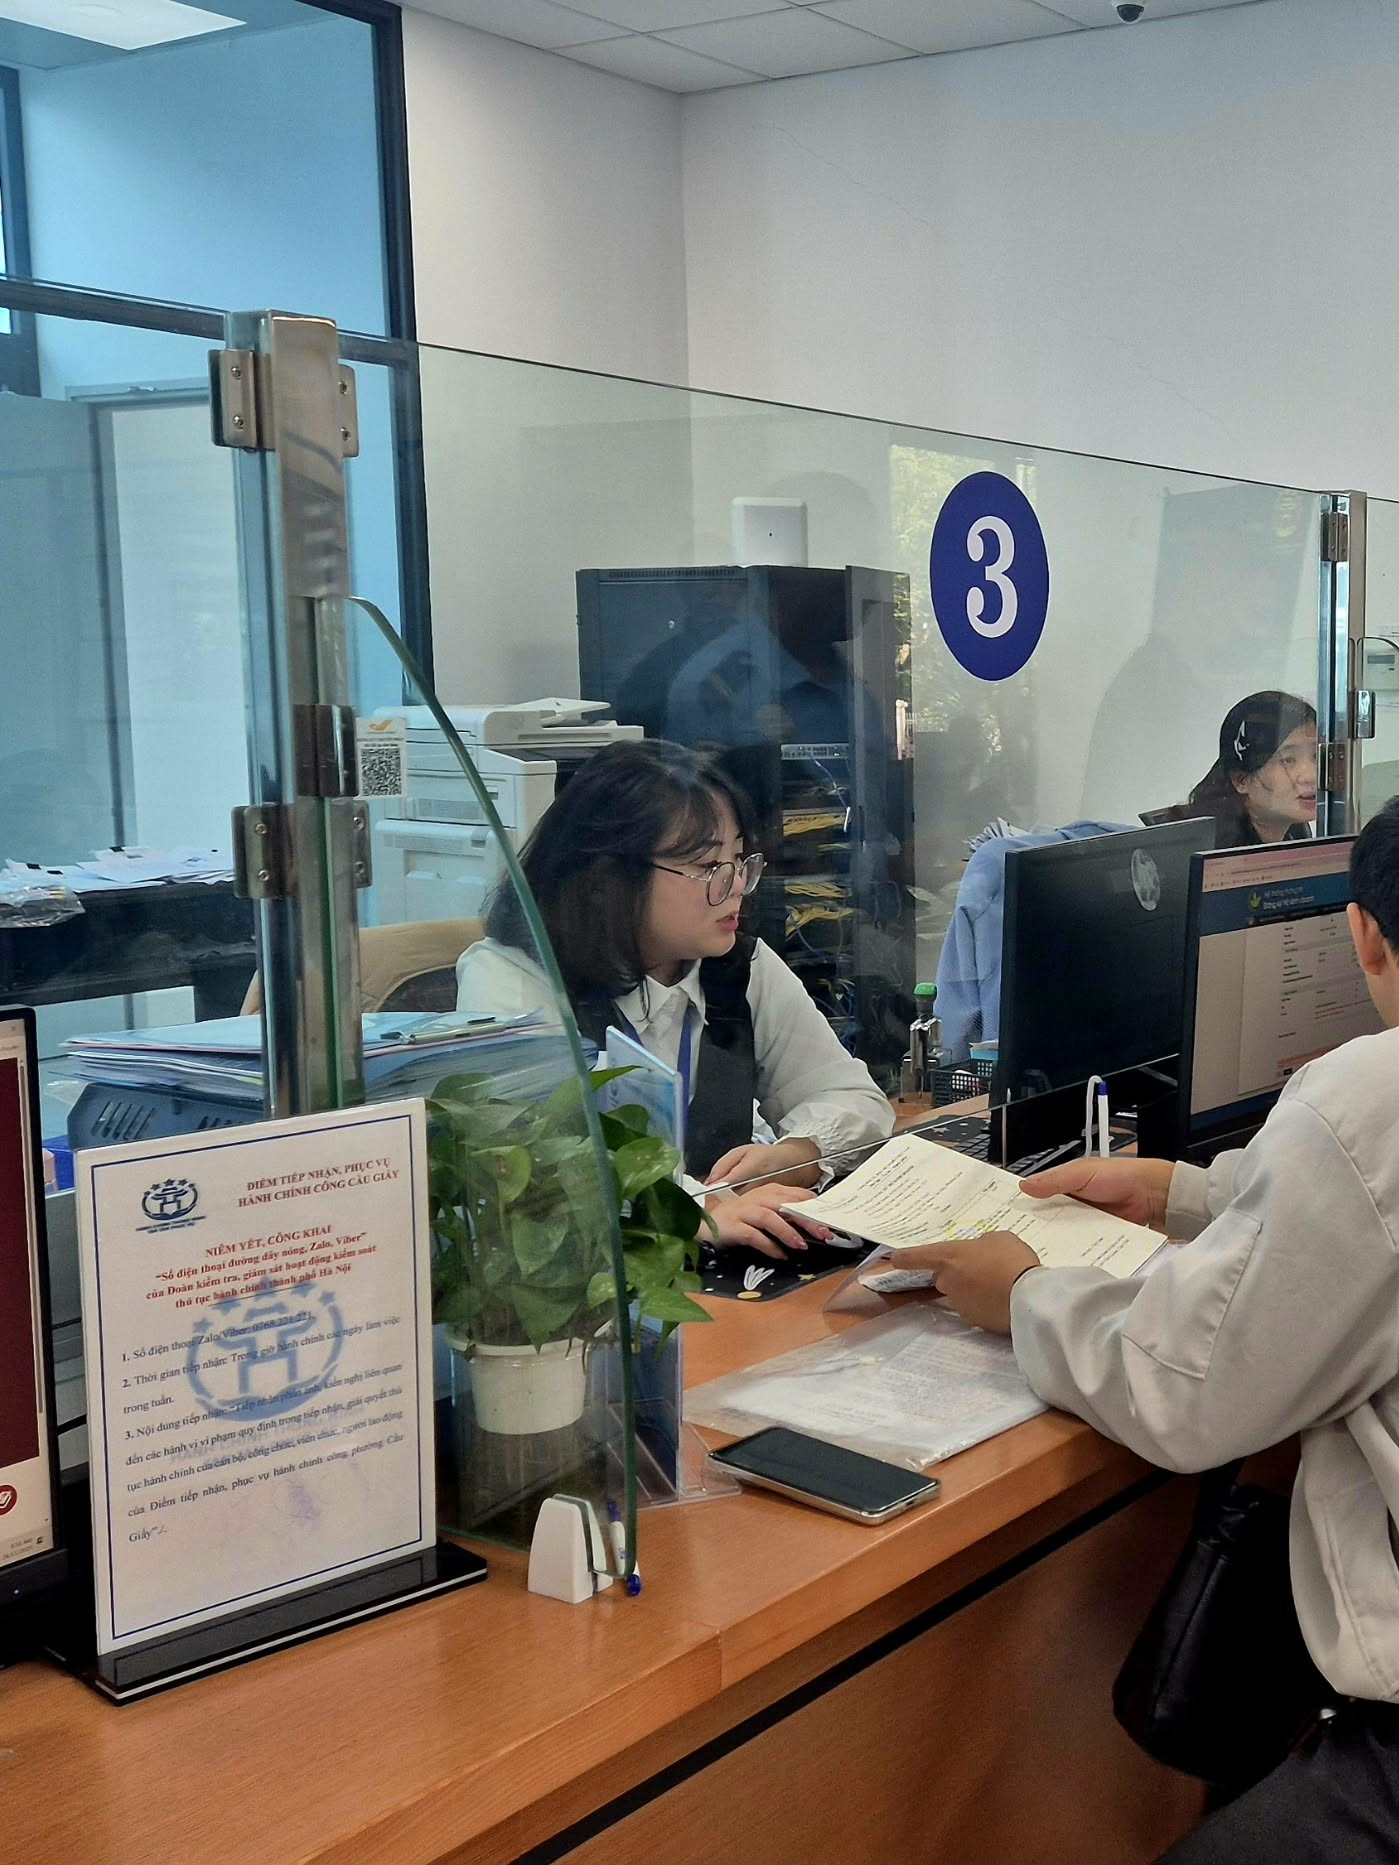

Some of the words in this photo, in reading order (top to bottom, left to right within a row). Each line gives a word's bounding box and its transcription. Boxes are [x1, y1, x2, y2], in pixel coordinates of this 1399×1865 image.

[966, 515, 1018, 639] 3
[344, 1160, 374, 1174] PHỤC
[274, 1186, 311, 1201] CHÍNH
[267, 1231, 300, 1245] CÔNG
[303, 1224, 332, 1239] KHAI
[201, 1261, 226, 1274] thoại
[146, 1288, 164, 1300] của
[167, 1282, 194, 1296] Đoàn
